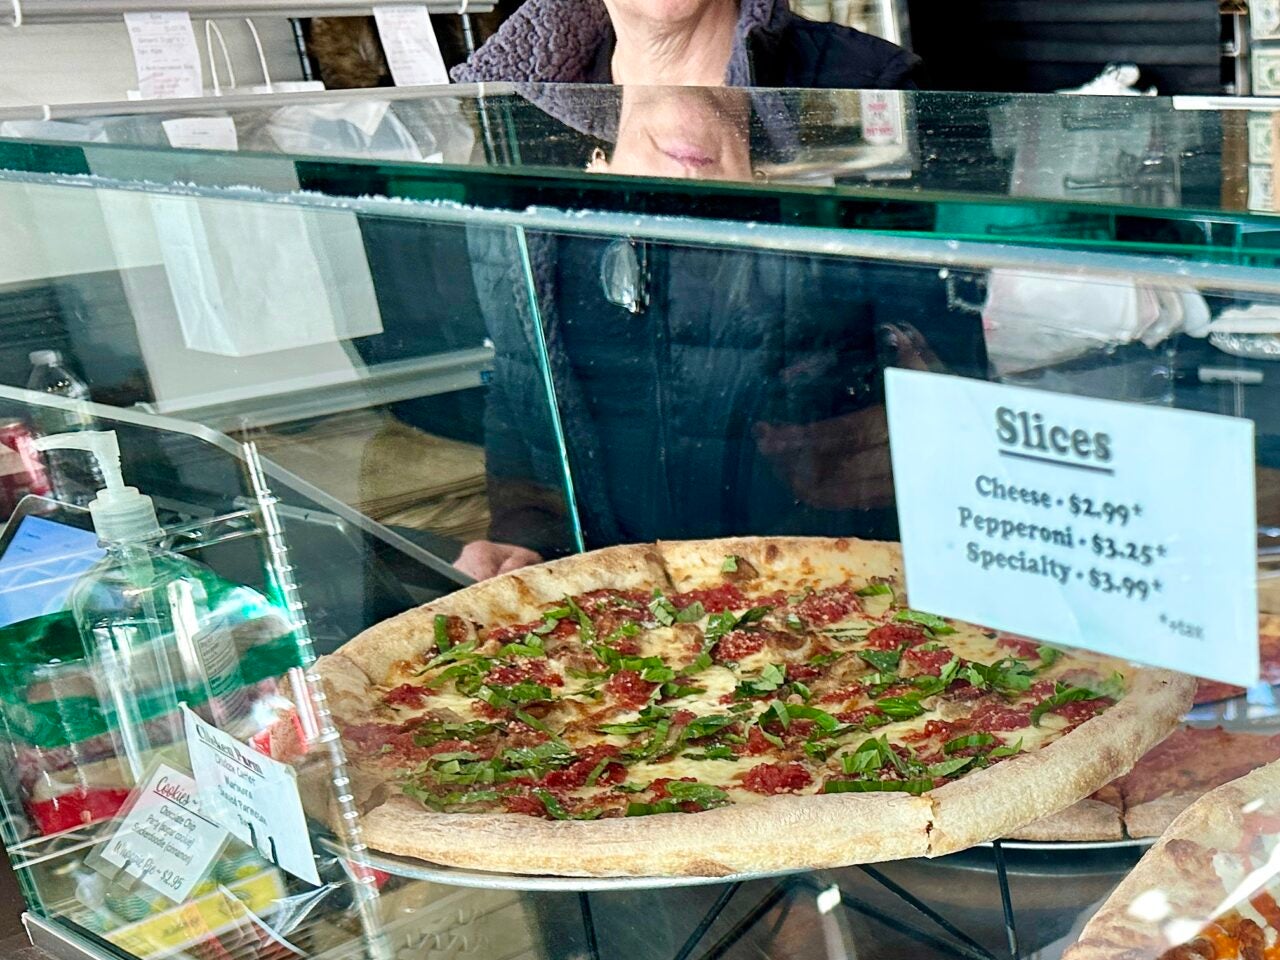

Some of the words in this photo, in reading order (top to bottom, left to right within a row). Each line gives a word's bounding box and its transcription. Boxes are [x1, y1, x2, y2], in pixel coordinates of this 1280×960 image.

[995, 405, 1113, 462] Slices
[975, 474, 1053, 509] Cheese
[958, 506, 1075, 549] Pepperoni
[967, 541, 1071, 585] Specialty
[156, 776, 190, 806] Cookies
[160, 869, 184, 891] $2.95
